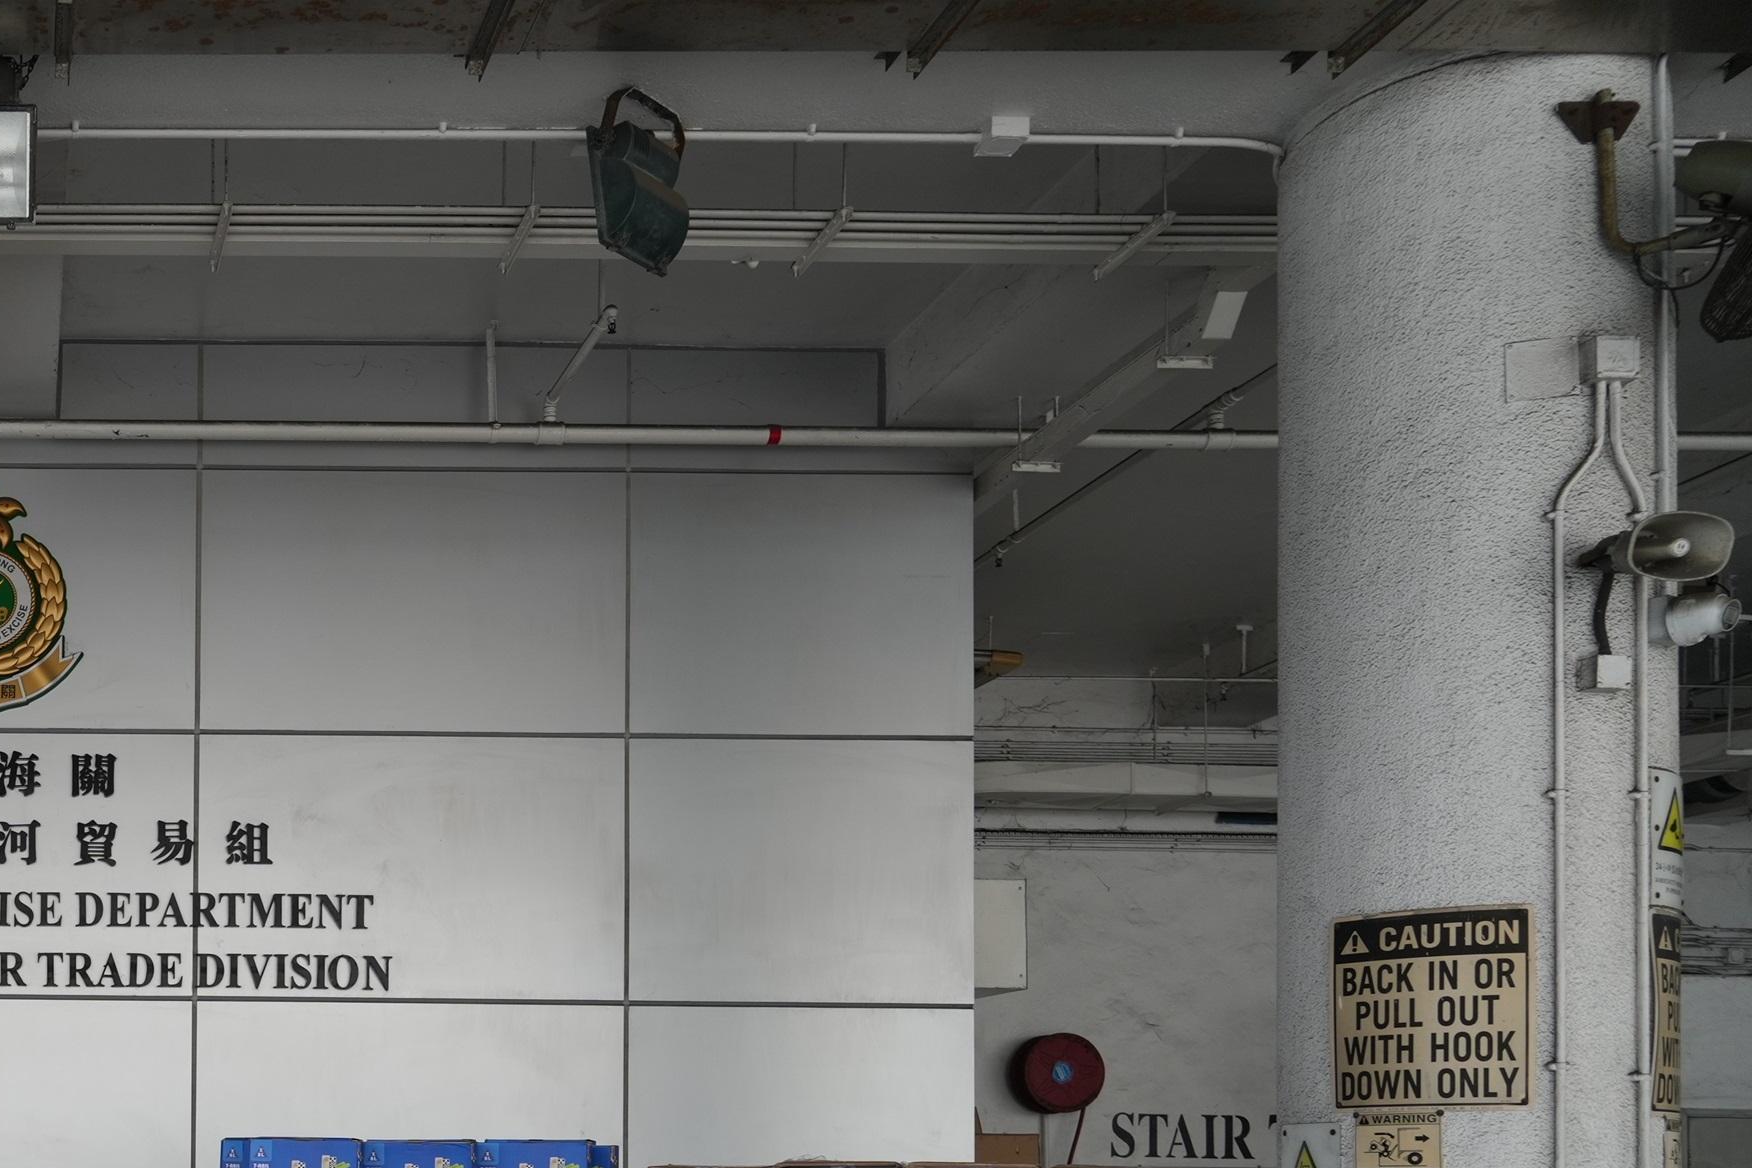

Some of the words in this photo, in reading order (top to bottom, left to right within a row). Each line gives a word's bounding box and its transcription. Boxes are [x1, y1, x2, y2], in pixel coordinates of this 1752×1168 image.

[1, 604, 28, 638] EXCISE
[75, 892, 374, 930] DEPARTMENT
[1378, 919, 1520, 952] CAUTION
[37, 952, 184, 988] TRADE
[195, 954, 392, 991] DIVISION
[1342, 963, 1414, 997] BACK
[1428, 960, 1458, 990] IN
[1474, 958, 1516, 988] OR
[1355, 998, 1423, 1030] PULL
[1437, 995, 1500, 1026] OUT
[1344, 1034, 1415, 1066] WITH
[1430, 1031, 1517, 1063] HOOK
[1341, 1069, 1422, 1100] DOWN
[1437, 1067, 1519, 1099] ONLY
[1110, 1112, 1254, 1160] STAIR
[1372, 1114, 1437, 1123] WARNING
